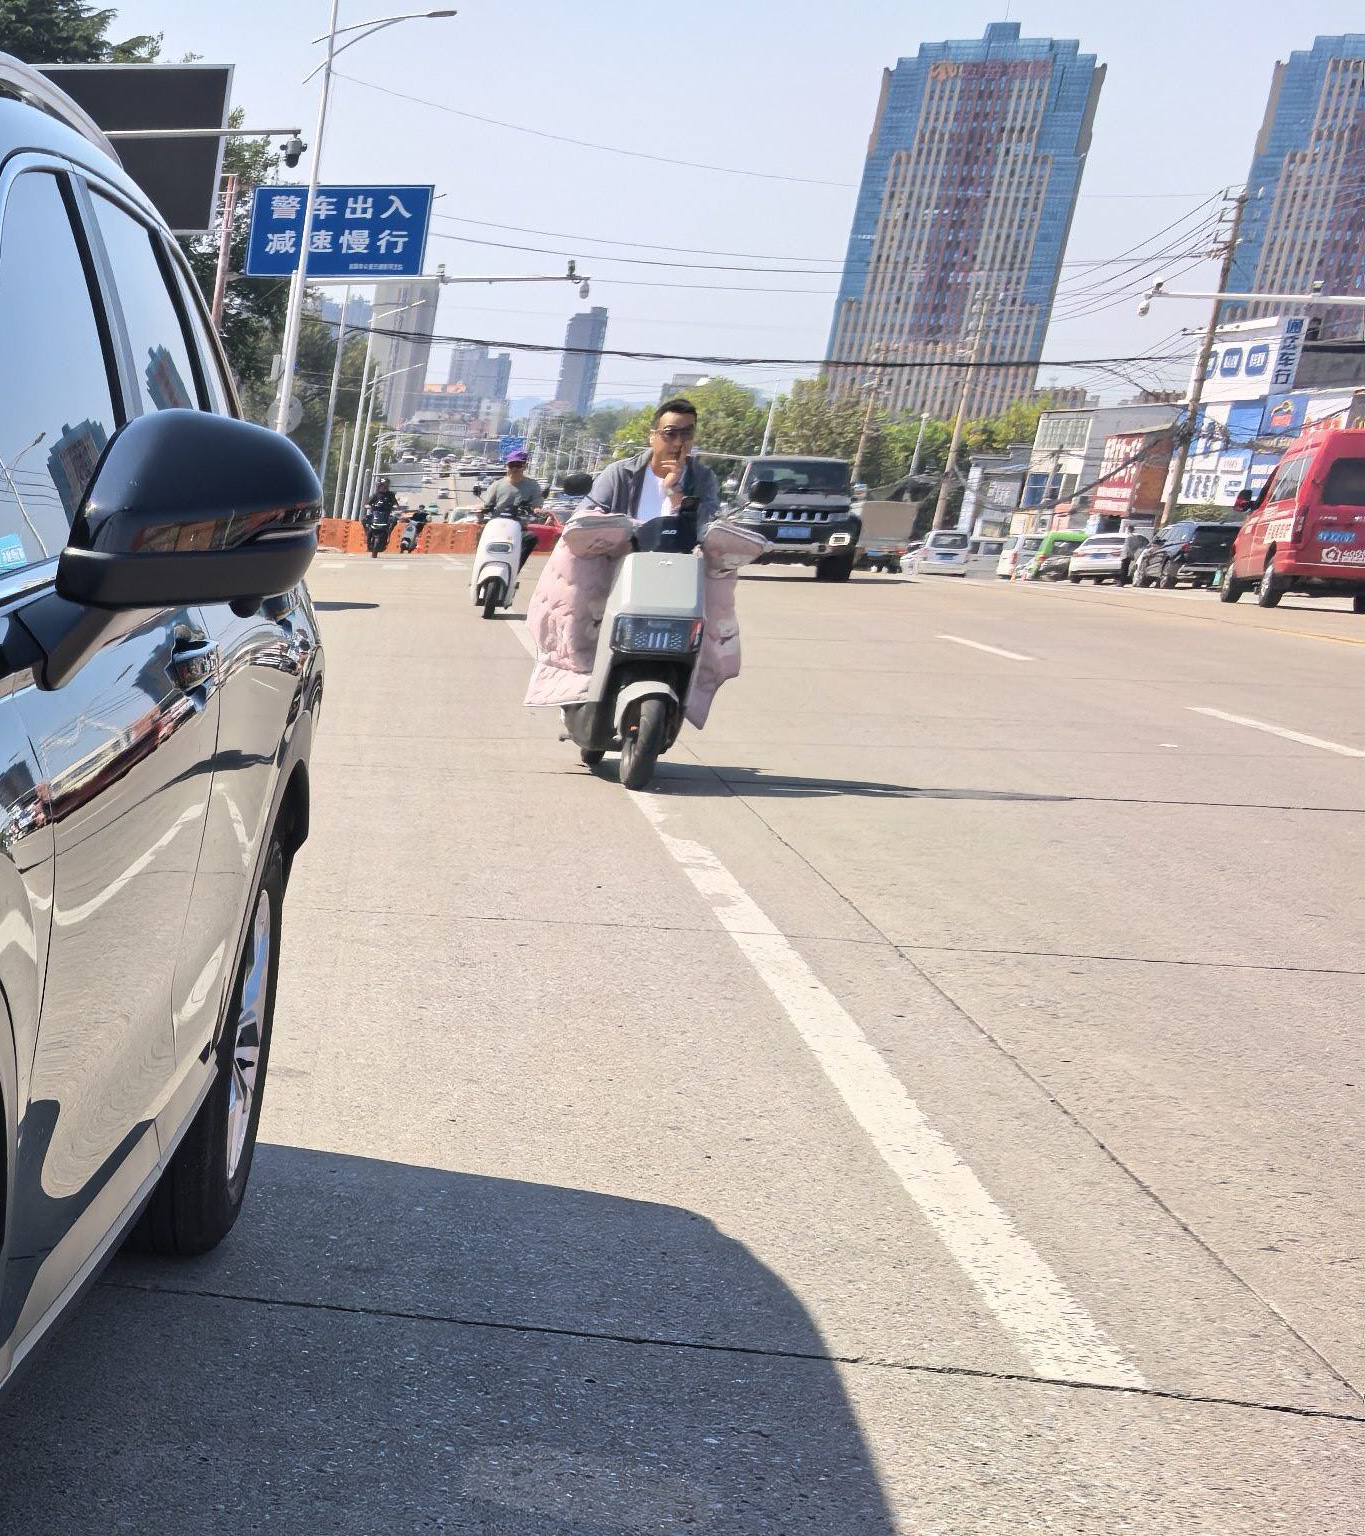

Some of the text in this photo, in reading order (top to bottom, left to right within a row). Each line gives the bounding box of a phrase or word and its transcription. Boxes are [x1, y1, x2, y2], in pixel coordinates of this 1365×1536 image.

[270, 195, 413, 220] 警车出入
[265, 229, 409, 255] 减速慢行
